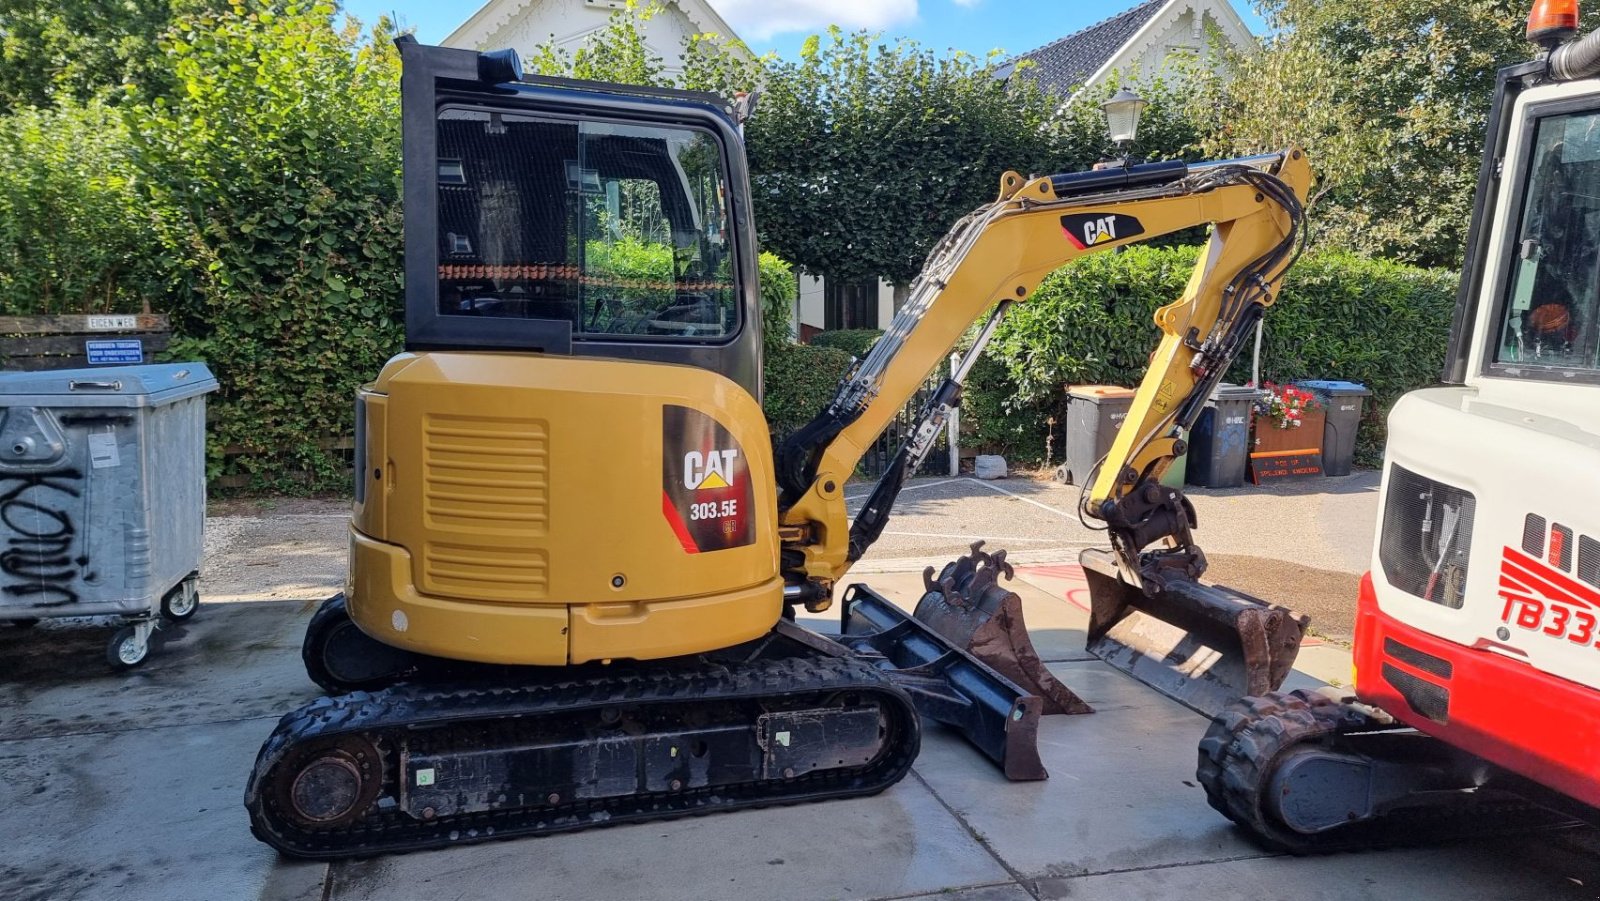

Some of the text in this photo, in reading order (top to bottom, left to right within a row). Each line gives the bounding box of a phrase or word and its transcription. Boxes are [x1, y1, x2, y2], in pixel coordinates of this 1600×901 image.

[1084, 215, 1116, 245] CAT
[90, 317, 134, 328] EIGEN WEG
[684, 449, 738, 491] CAT
[690, 499, 738, 521] 303.5E
[722, 519, 737, 534] CR
[1497, 589, 1600, 653] TB33
